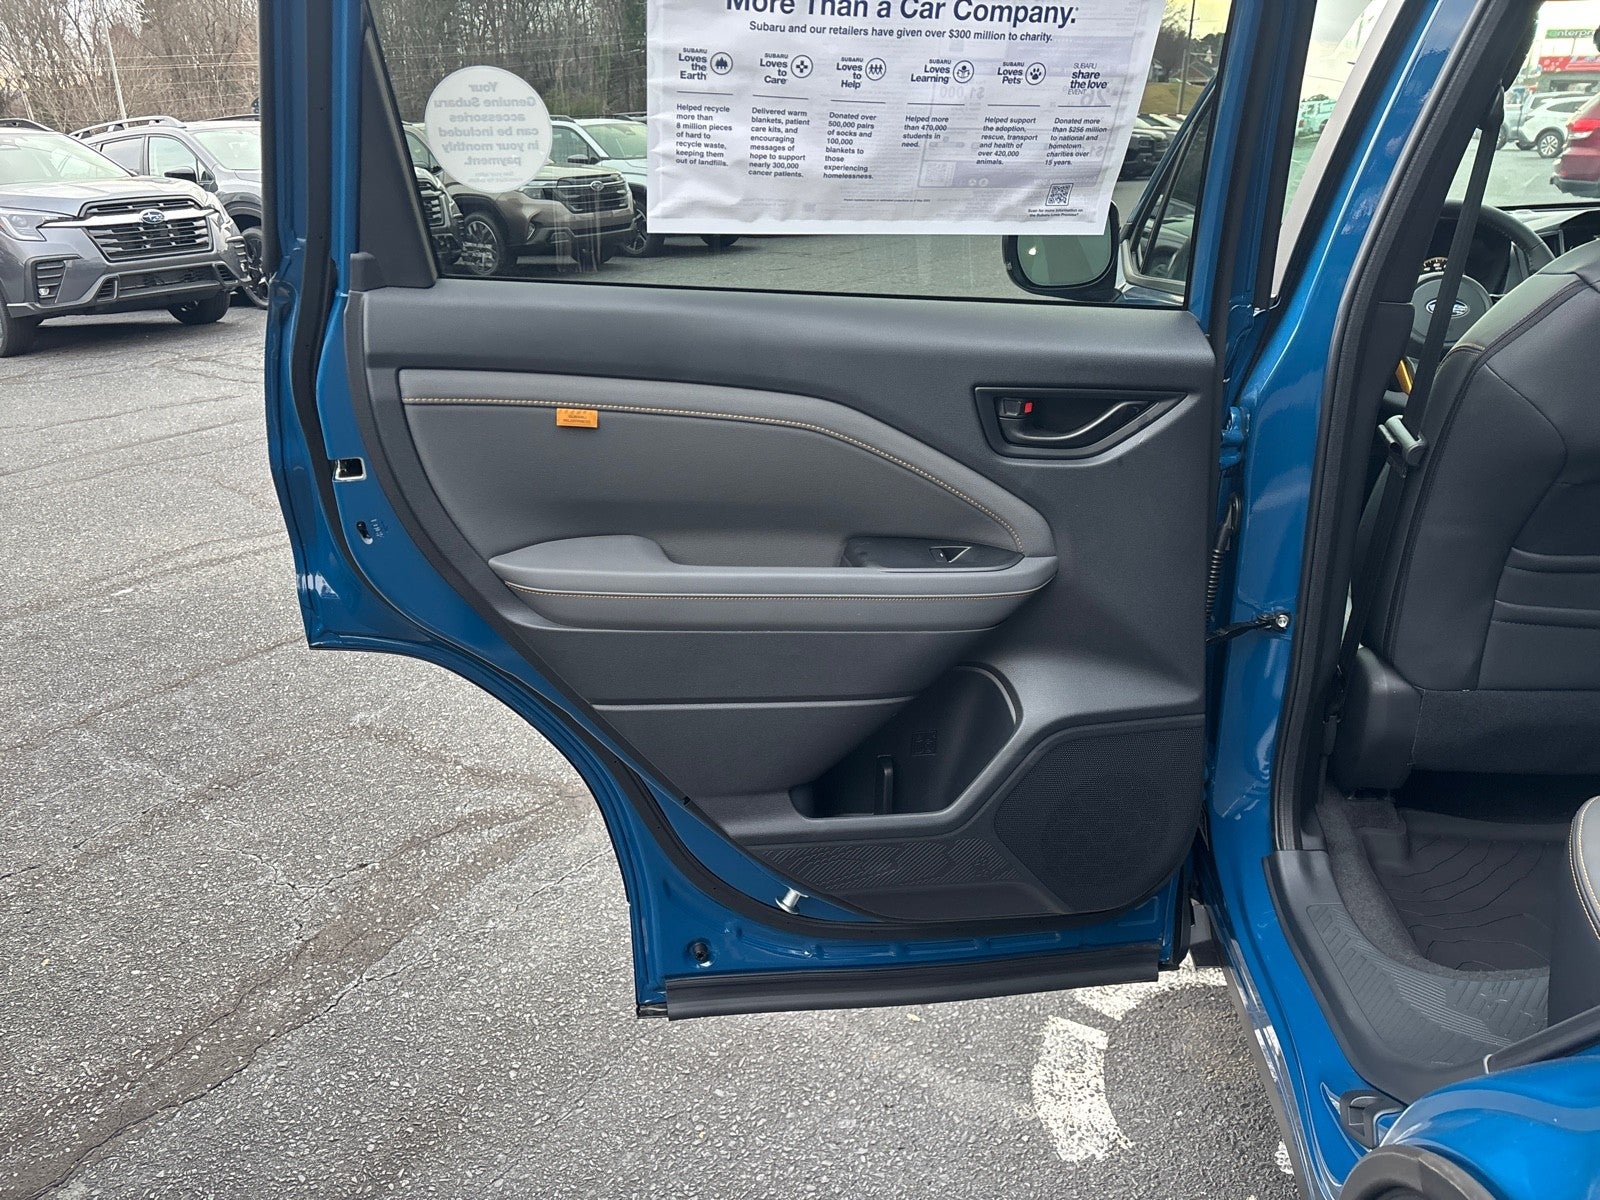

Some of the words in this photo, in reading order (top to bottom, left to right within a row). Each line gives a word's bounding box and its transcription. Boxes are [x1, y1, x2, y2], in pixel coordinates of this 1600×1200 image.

[876, 0, 892, 18] a
[899, 0, 946, 20] Car
[953, 0, 1076, 29] Company.
[749, 21, 786, 32] Subaru
[788, 24, 807, 33] and
[810, 26, 826, 34] our
[829, 26, 868, 36] retailers
[871, 27, 894, 37] have
[896, 28, 922, 39] given
[924, 29, 946, 38] over
[948, 29, 971, 39] $300
[973, 30, 1006, 40] million
[1008, 31, 1018, 41] to
[1019, 31, 1053, 42] charity.
[678, 53, 707, 64] Loves
[759, 58, 788, 68] Loves
[691, 63, 707, 72] the
[836, 62, 863, 72] Loves
[924, 64, 950, 74] Loves
[997, 67, 1023, 76] Loves
[680, 71, 707, 81] Earth
[777, 68, 787, 77] to
[853, 72, 862, 80] to
[1071, 69, 1101, 80] share
[764, 75, 787, 85] Care
[910, 74, 950, 84] Learning
[1002, 76, 1022, 85] Pets
[841, 79, 861, 90] Help
[1070, 80, 1086, 89] the
[1087, 80, 1108, 89] love
[676, 103, 702, 113] Helped
[703, 105, 730, 113] recycle
[752, 107, 786, 116] Delivered
[696, 113, 713, 121] than
[829, 112, 859, 120] Donated
[905, 115, 931, 124] Helped
[984, 116, 1010, 125] Helped
[1010, 117, 1036, 125] support
[751, 116, 783, 125] blankets,
[784, 118, 810, 127] patient
[828, 121, 855, 130] 500,000
[856, 122, 875, 130] pairs
[1054, 117, 1081, 125] Donated
[682, 122, 707, 130] million
[708, 124, 733, 133] pieces
[768, 125, 783, 134] kits,
[784, 126, 798, 134] and
[920, 124, 947, 132] 470,000
[995, 125, 1027, 134] adoption,
[1068, 126, 1084, 134] $256
[676, 131, 684, 139] of
[685, 131, 702, 139] hard
[859, 130, 872, 138] and
[903, 132, 932, 140] students
[981, 134, 1006, 142] rescue,
[1007, 134, 1038, 142] transport
[750, 135, 795, 144] encouraging
[827, 138, 853, 146] 100,000
[676, 140, 703, 149] recycle
[704, 142, 727, 150] waste,
[750, 144, 787, 153] messages
[1048, 142, 1082, 150] hometown
[676, 149, 705, 158] keeping
[705, 150, 724, 158] them
[826, 146, 855, 154] blankets
[994, 150, 1020, 158] 420,000
[1046, 150, 1074, 158] charities
[750, 153, 768, 161] hope
[777, 154, 806, 162] support
[698, 159, 729, 167] landfills.
[749, 161, 771, 170] nearly
[772, 162, 799, 170] 300,000
[824, 164, 868, 173] experiencing
[773, 170, 804, 179] patients.
[823, 172, 874, 180] homelessness.
